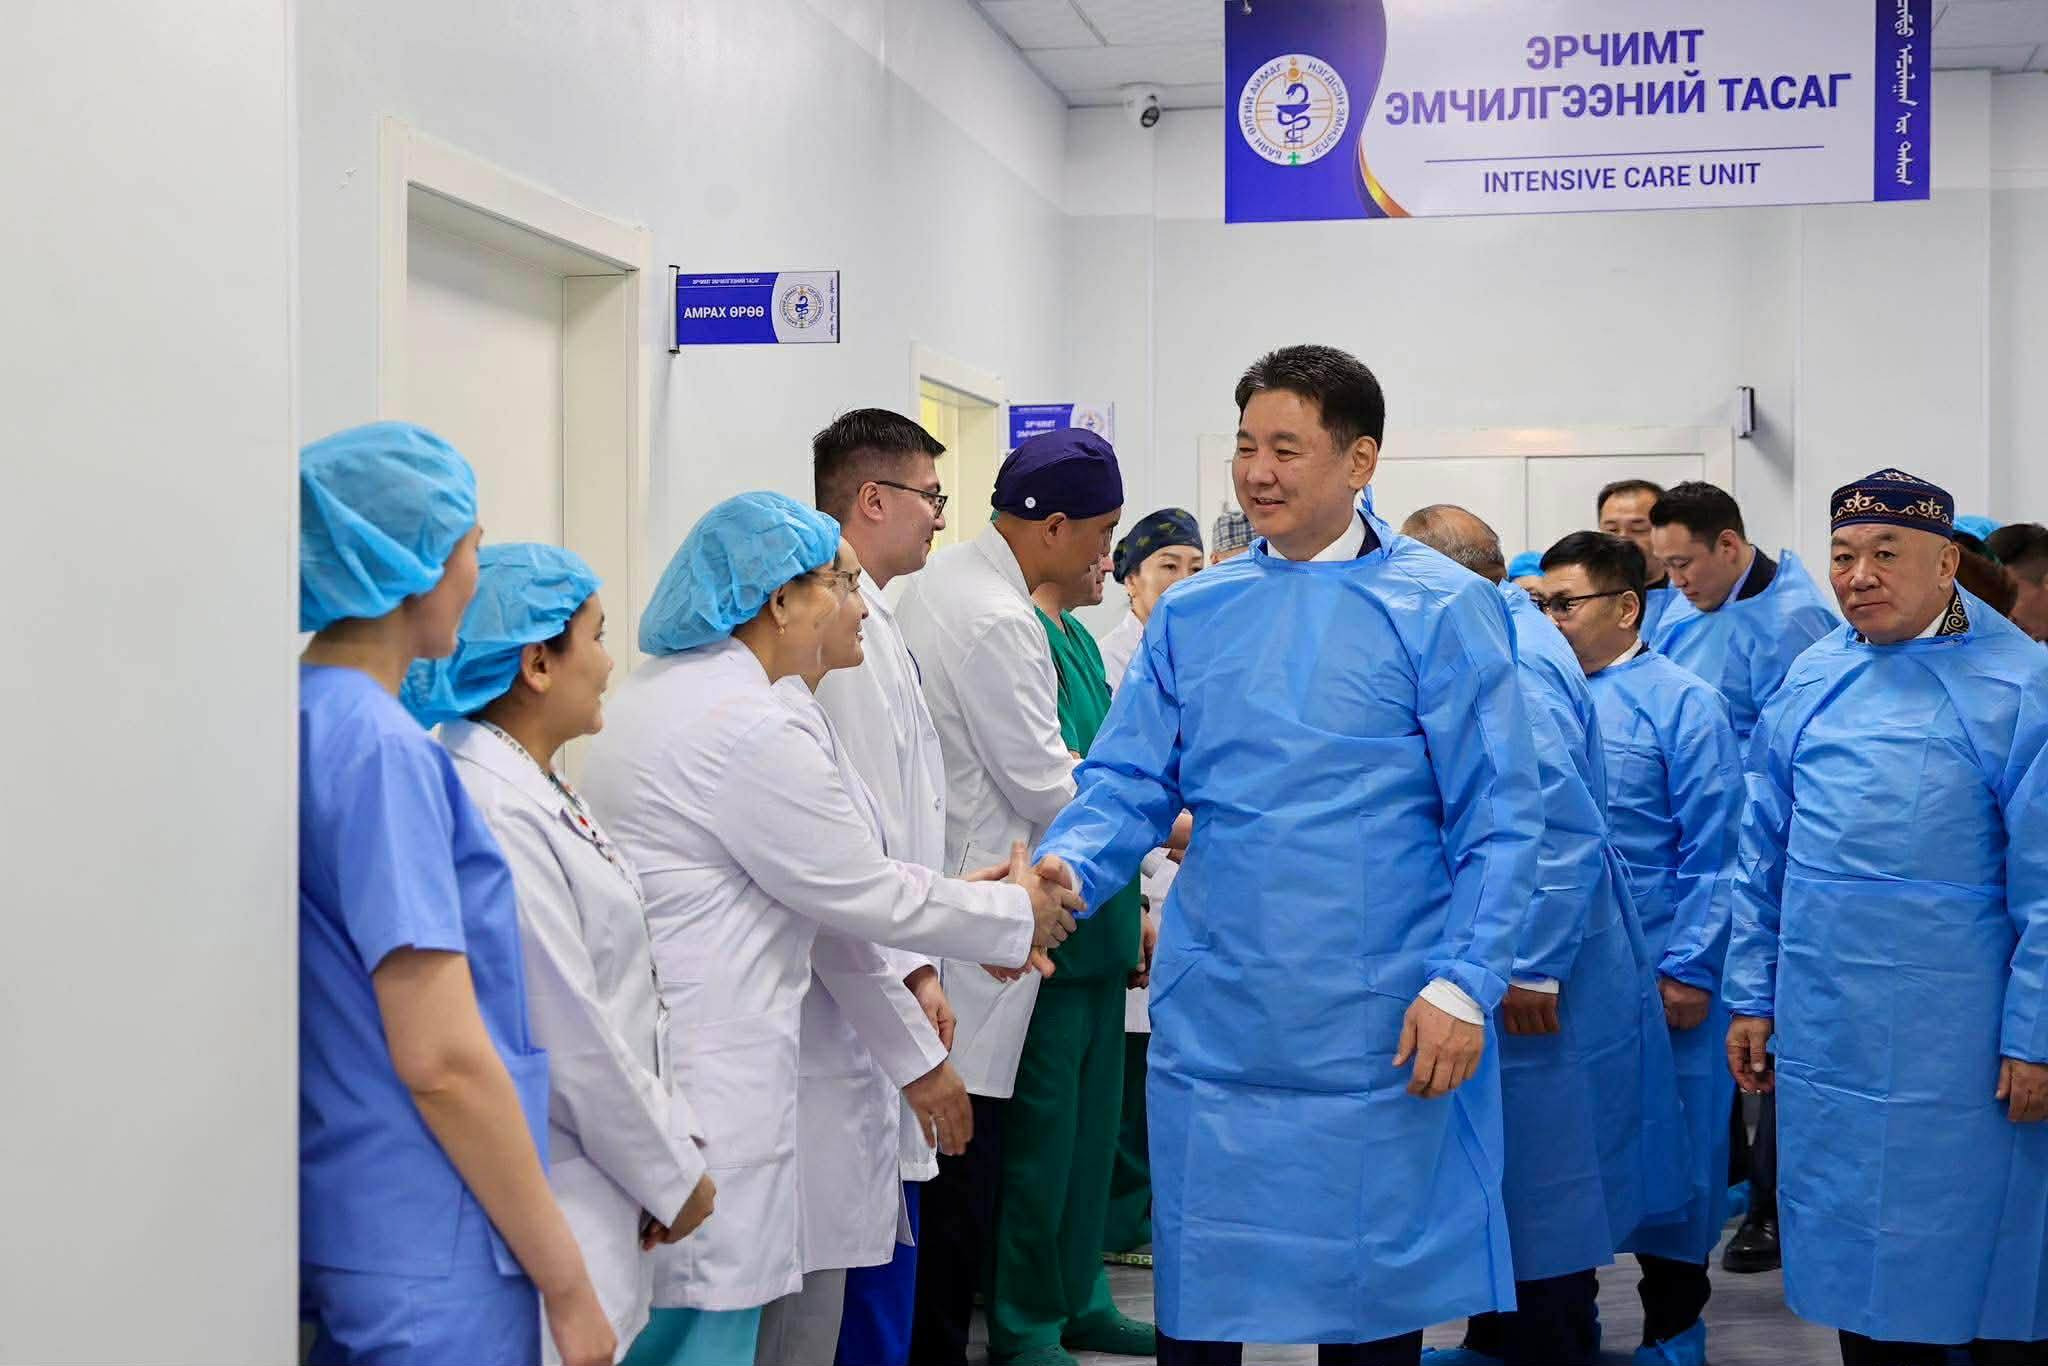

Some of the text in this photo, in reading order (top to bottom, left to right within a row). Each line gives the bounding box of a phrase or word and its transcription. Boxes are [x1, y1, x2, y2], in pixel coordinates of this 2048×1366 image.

[1527, 30, 1704, 70] ЭРЧИМТ
[1385, 69, 1852, 125] ЭМЧИЛГЭЭНИЙ ТАСАГ
[1484, 162, 1760, 193] INTENSIVE CARE UNIT
[684, 305, 765, 318] АМРАХ ӨРӨӨ
